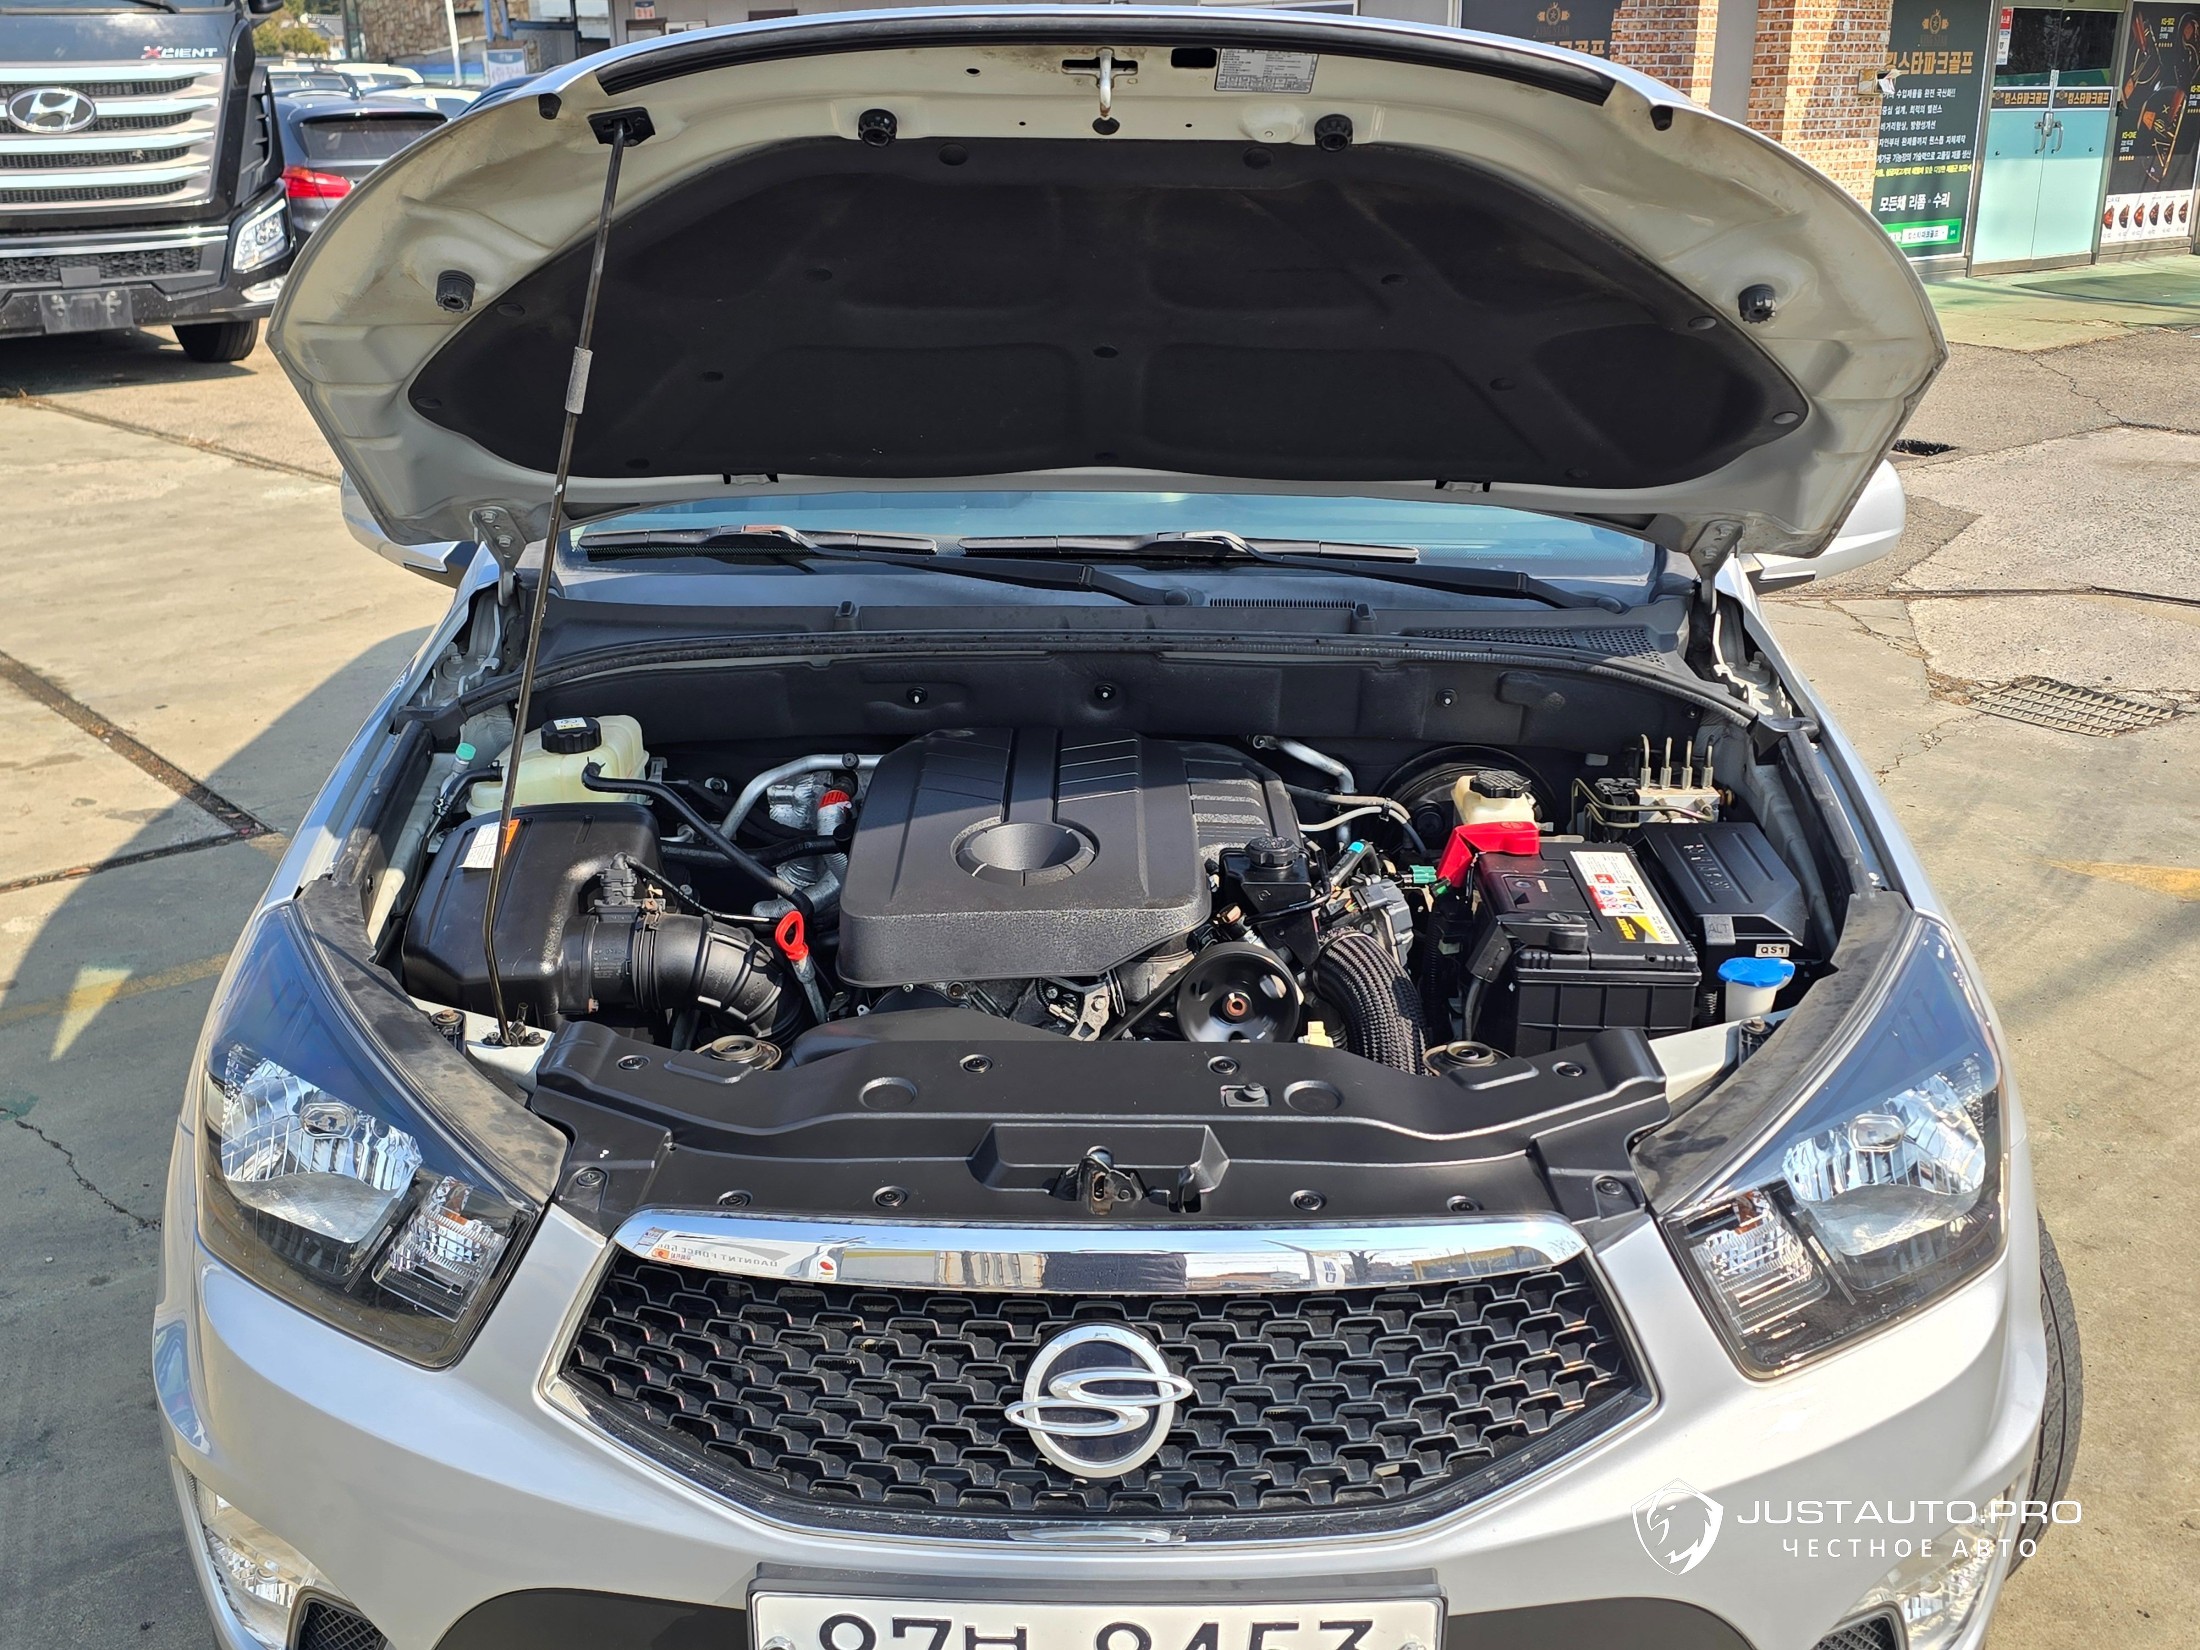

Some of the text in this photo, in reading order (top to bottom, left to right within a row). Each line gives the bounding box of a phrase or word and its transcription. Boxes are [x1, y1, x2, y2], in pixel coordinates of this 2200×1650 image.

[141, 46, 218, 59] XCIENT
[2004, 92, 2049, 105] 킹스타파크골프
[2067, 92, 2109, 105] 킹스타파크골프
[1908, 193, 1926, 210] 리폼
[1933, 191, 1951, 208] 수리
[1760, 946, 1785, 954] QS1
